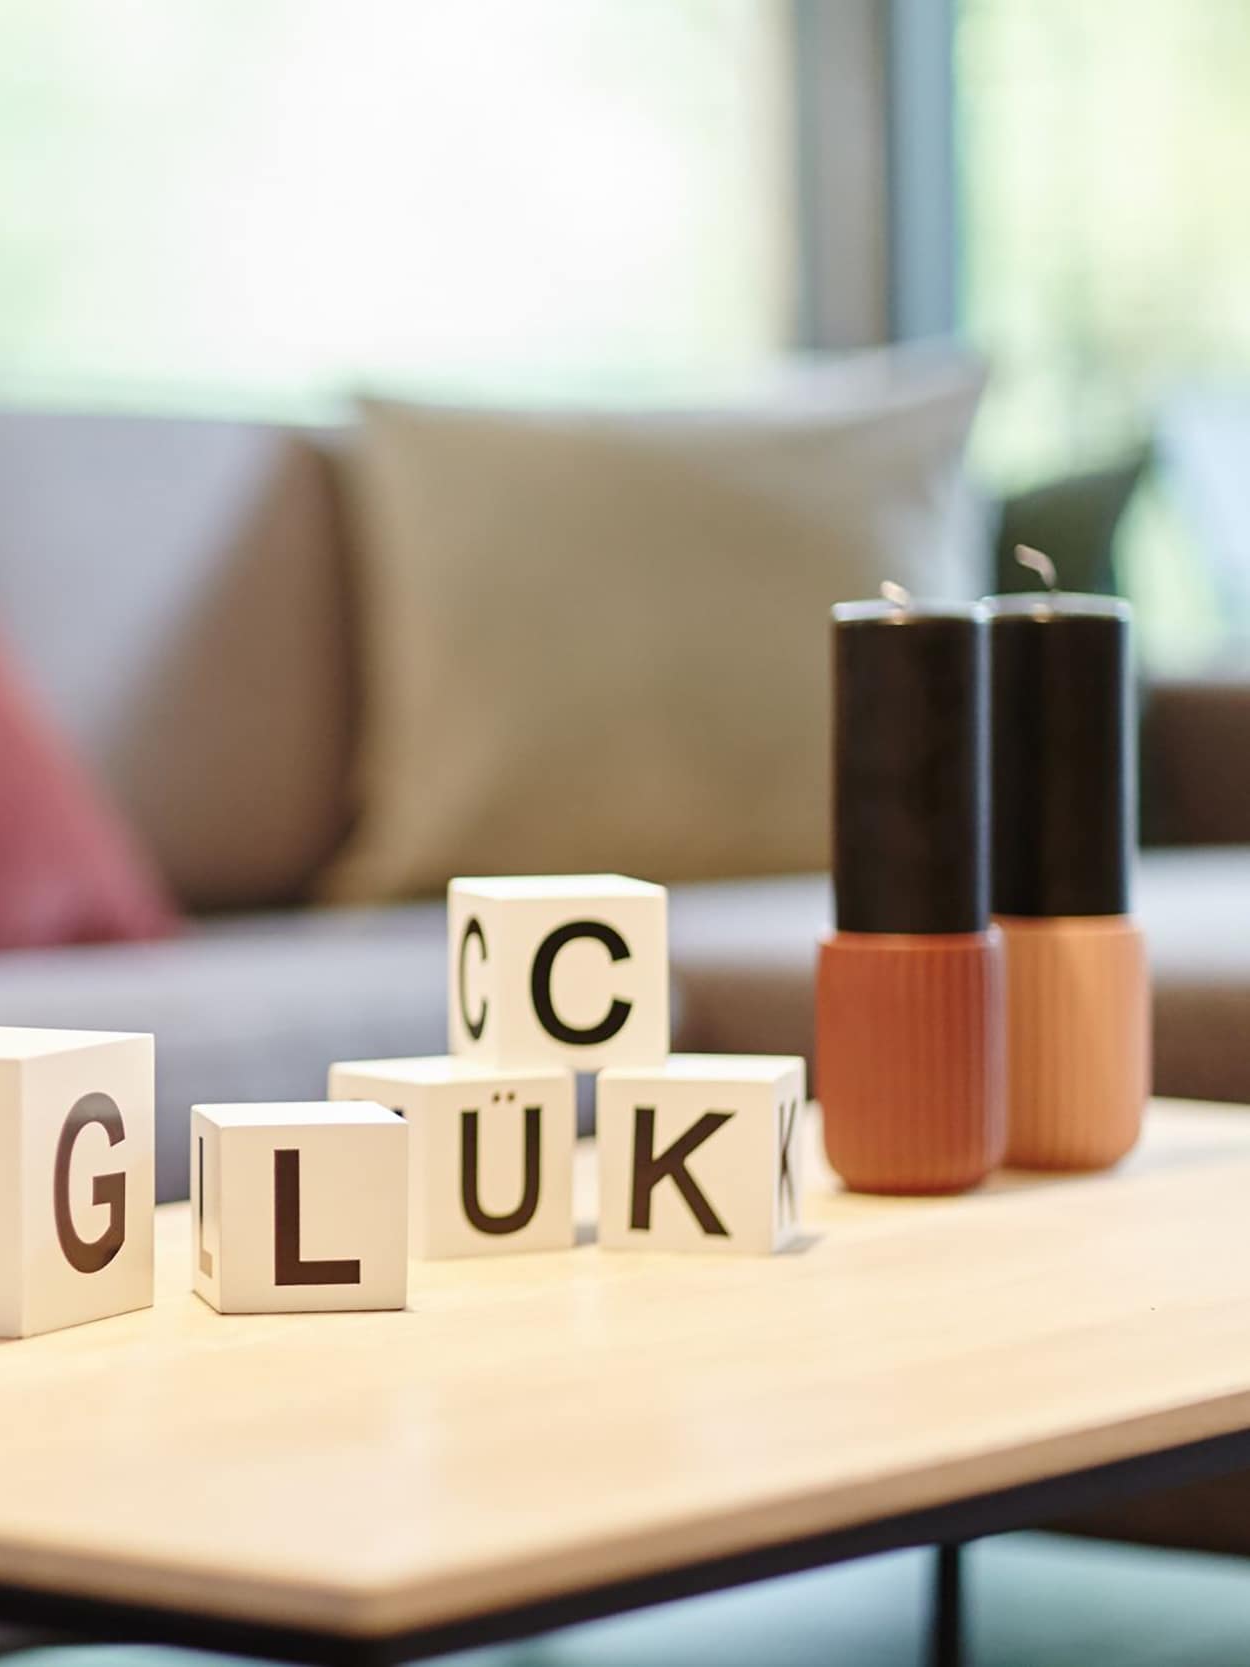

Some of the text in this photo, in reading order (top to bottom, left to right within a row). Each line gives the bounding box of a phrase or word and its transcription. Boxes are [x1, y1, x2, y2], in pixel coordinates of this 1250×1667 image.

[459, 916, 488, 1041] C
[530, 921, 632, 1046] C
[54, 1092, 126, 1274] G
[274, 1149, 361, 1287] L
[461, 1090, 543, 1236] Ü
[629, 1107, 736, 1238] K
[778, 1099, 796, 1229] K
